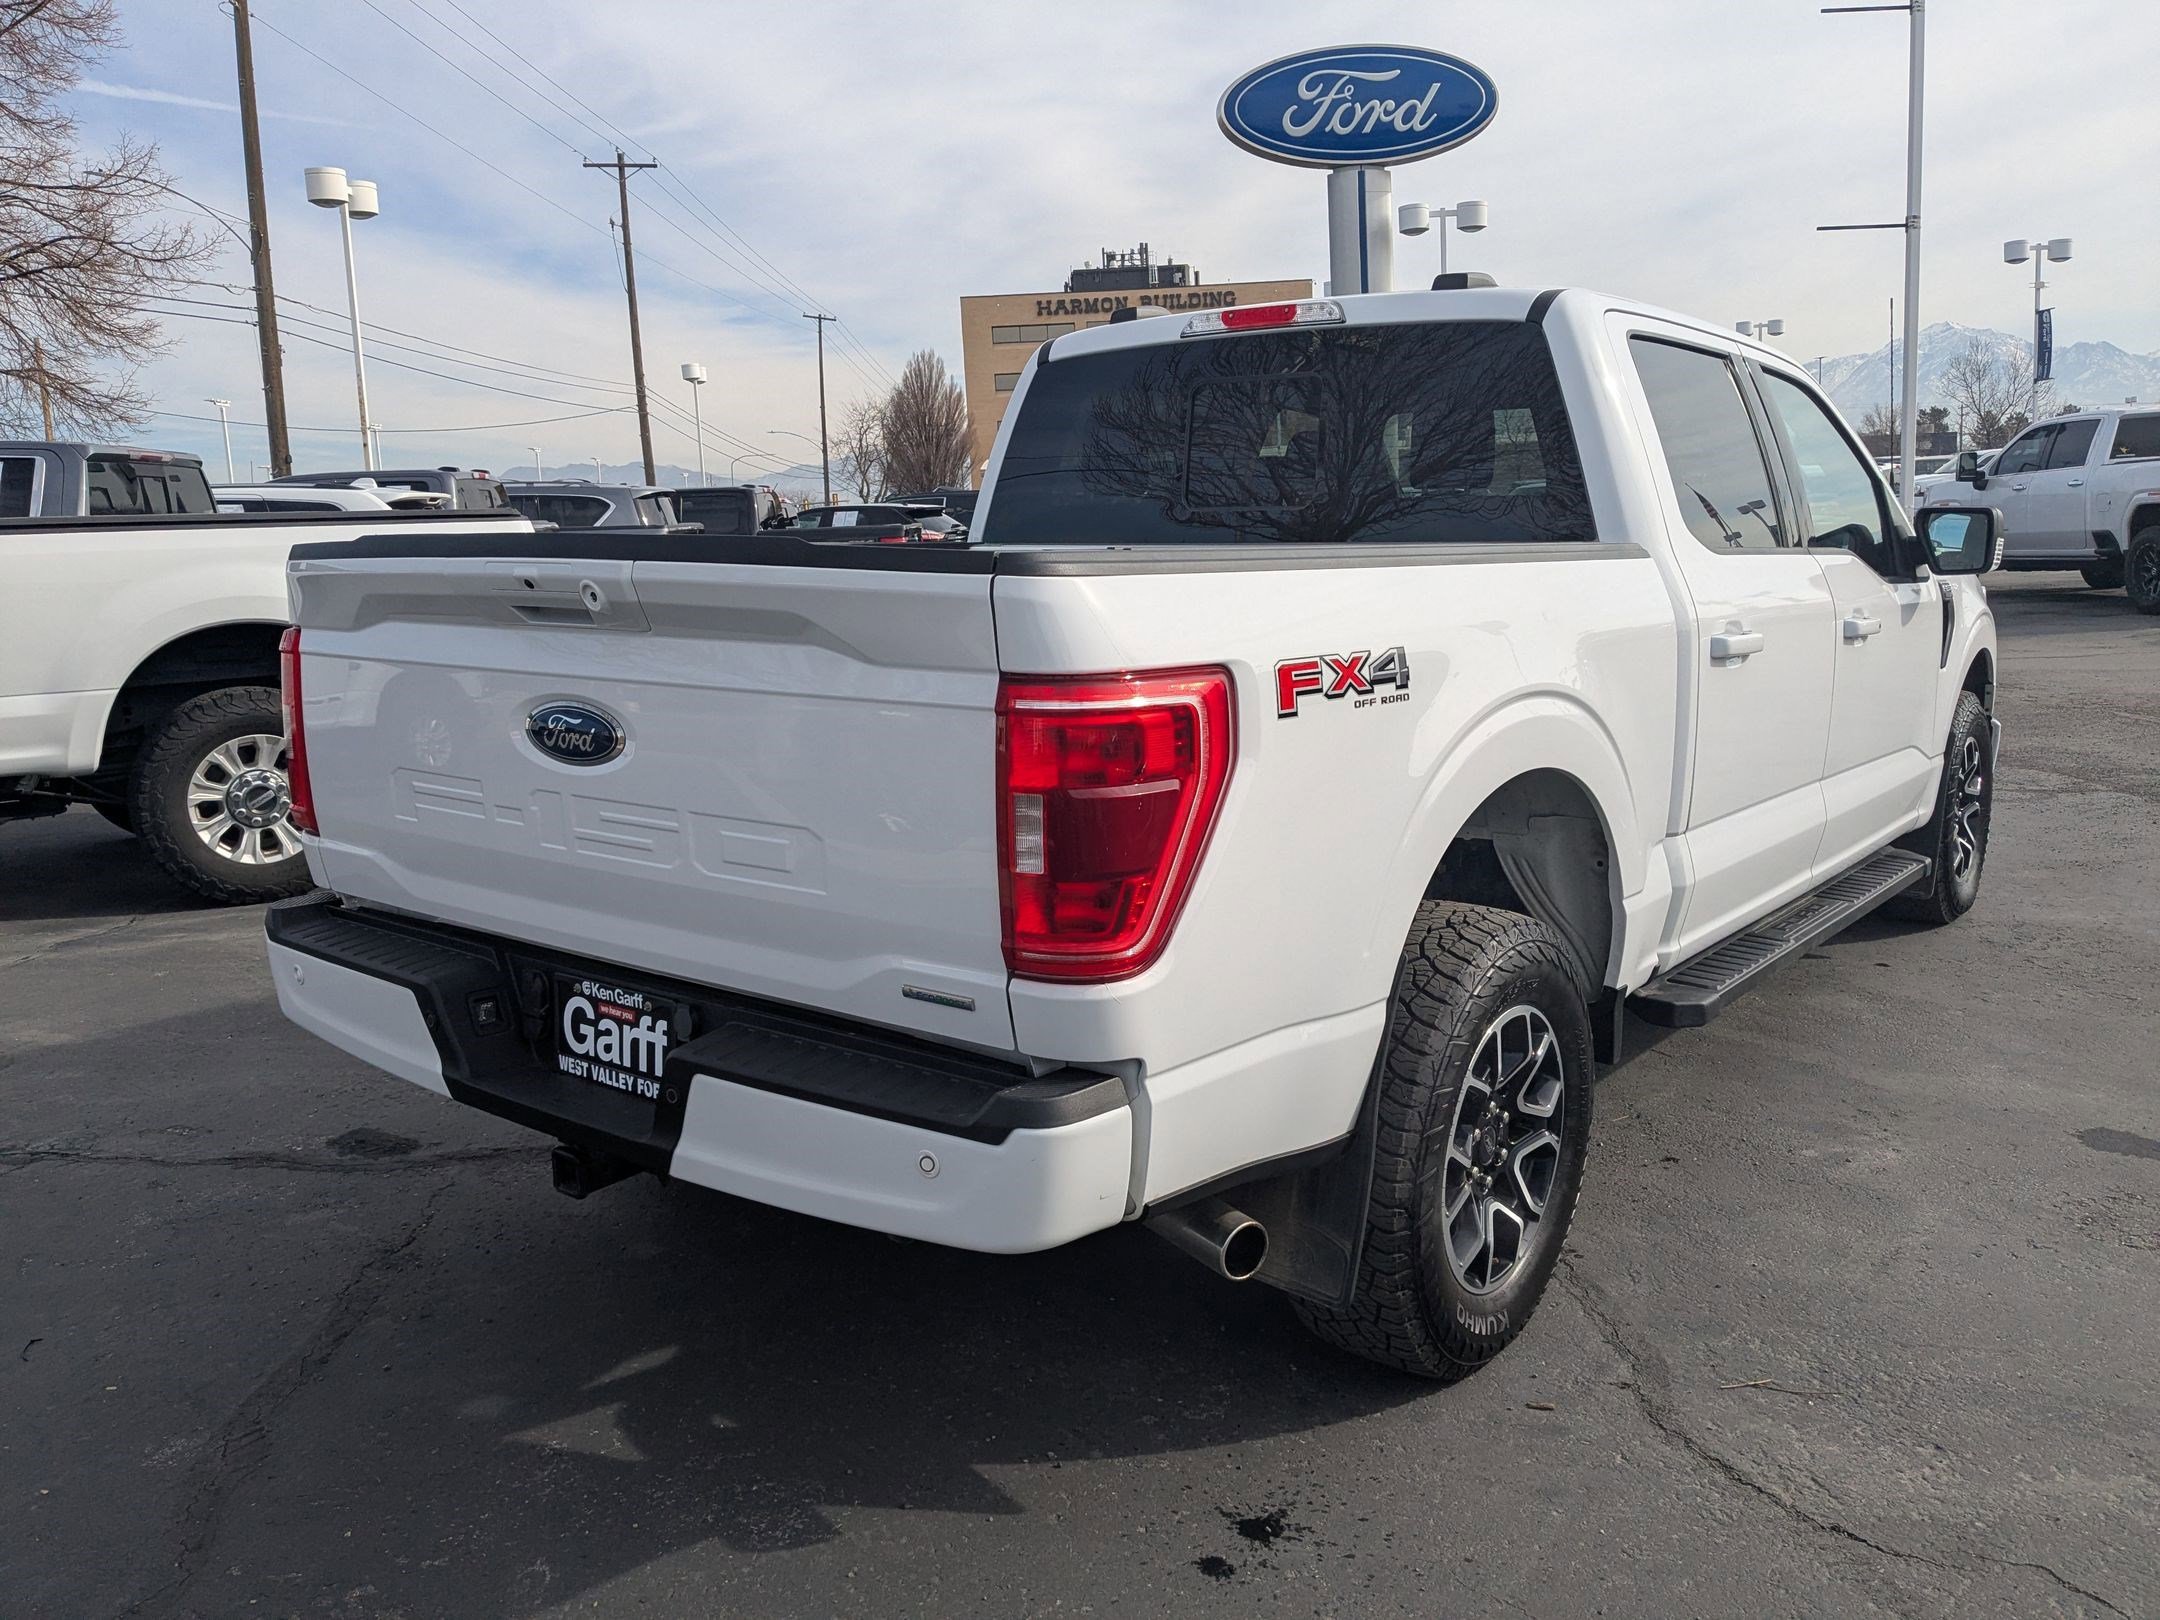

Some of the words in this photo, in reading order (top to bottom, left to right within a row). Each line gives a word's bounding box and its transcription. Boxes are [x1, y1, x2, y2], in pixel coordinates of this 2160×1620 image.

[1282, 69, 1442, 137] Ford
[1036, 296, 1129, 317] HARMON
[1139, 291, 1237, 310] BUILDING
[1274, 646, 1410, 720] FX4
[1354, 697, 1377, 709] OFF
[1381, 693, 1410, 705] ROAD
[543, 714, 596, 752] Ford
[391, 766, 828, 896] F-150
[609, 1006, 622, 1017] hear
[622, 1011, 633, 1020] you
[563, 996, 668, 1077] Garff
[558, 1054, 589, 1078] WEST
[591, 1064, 635, 1092] VALLEY
[1456, 1302, 1510, 1335] KUMHO
